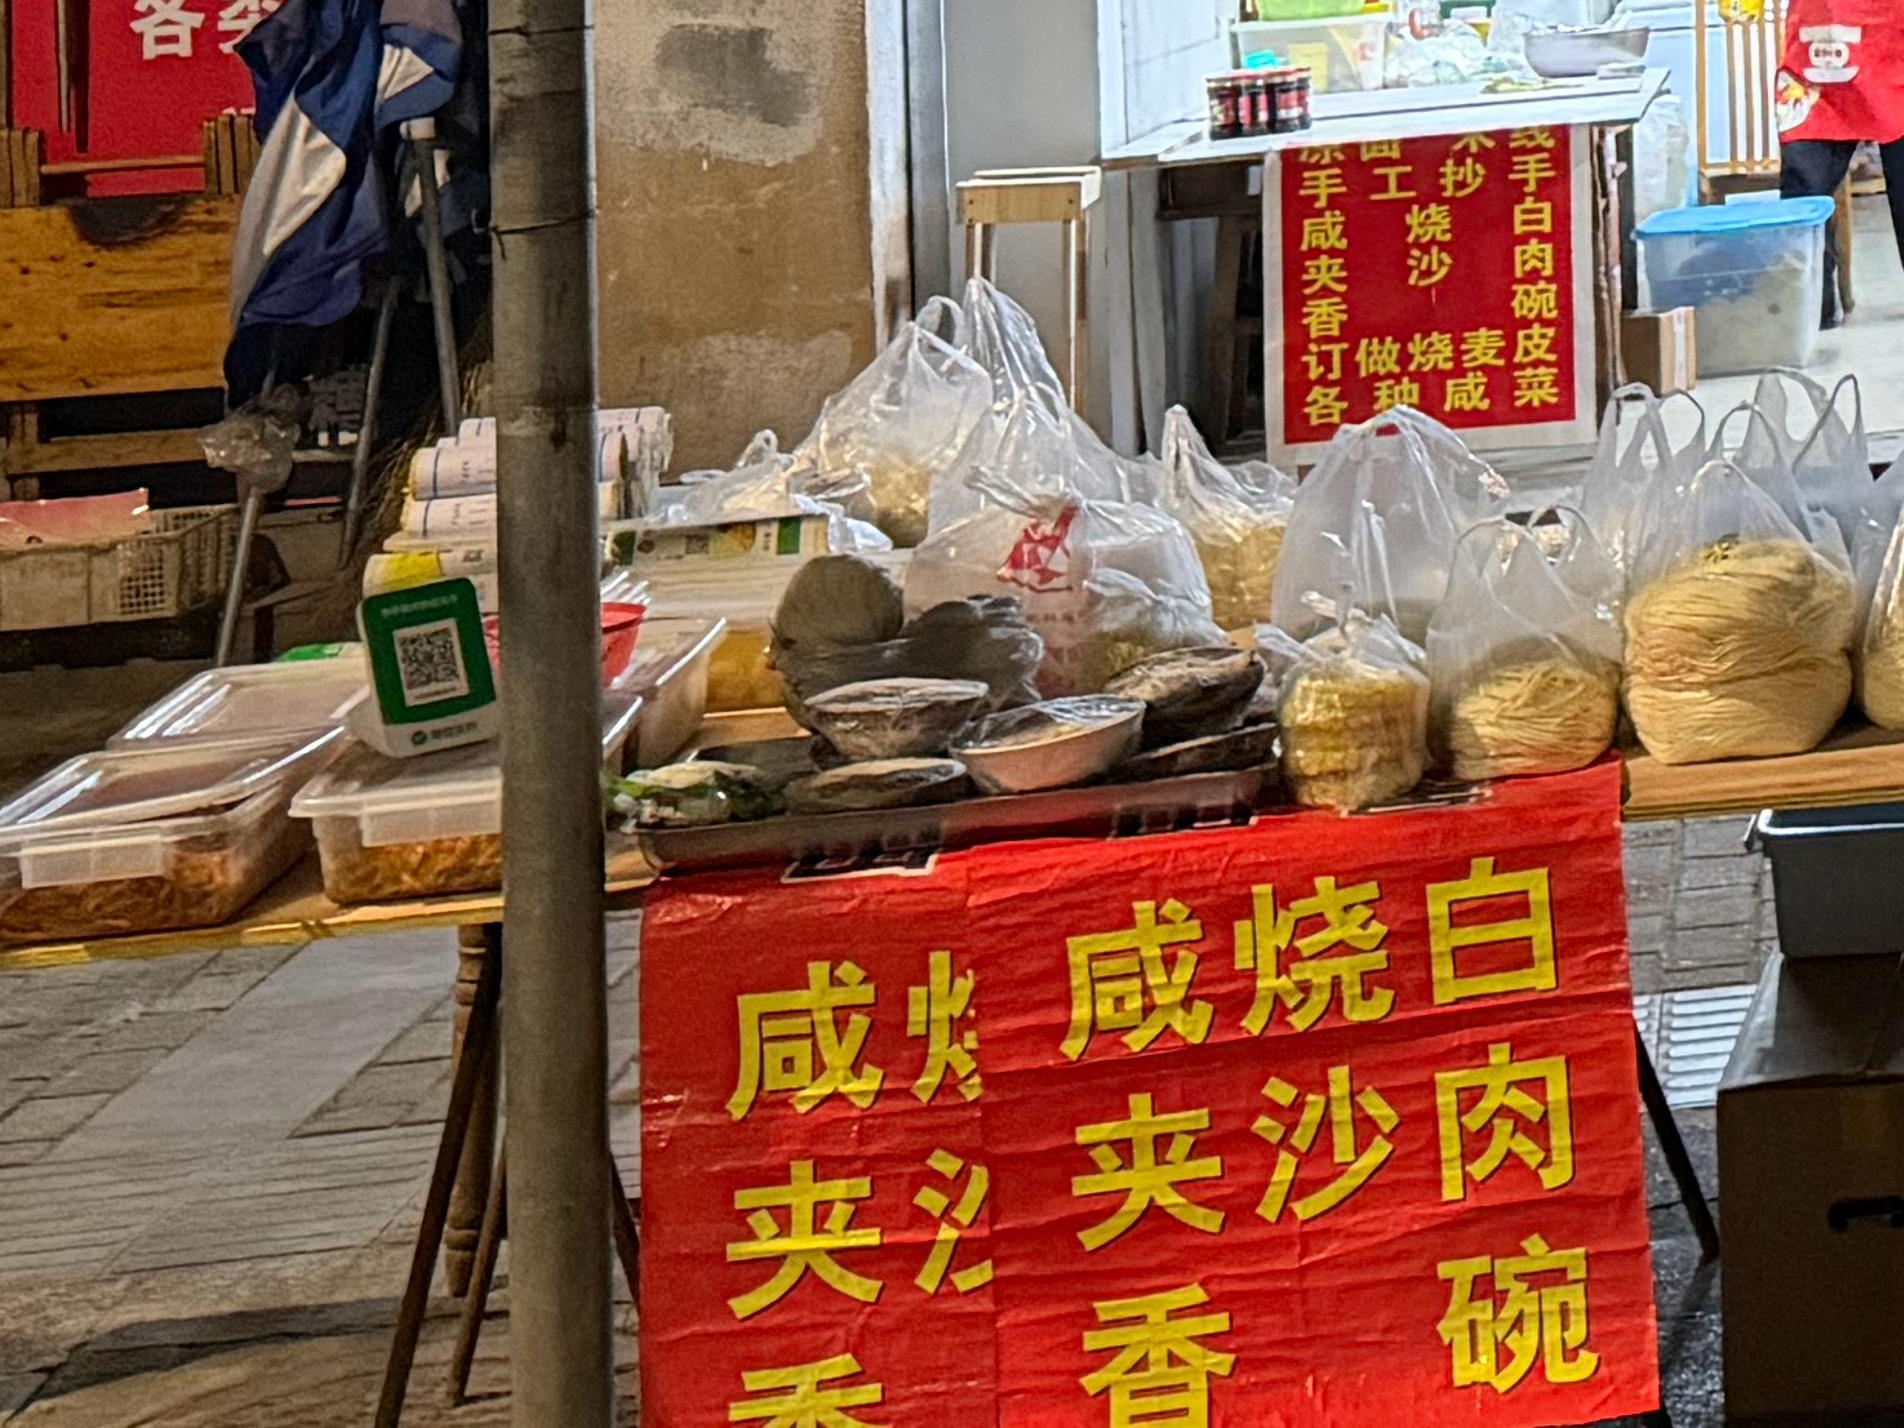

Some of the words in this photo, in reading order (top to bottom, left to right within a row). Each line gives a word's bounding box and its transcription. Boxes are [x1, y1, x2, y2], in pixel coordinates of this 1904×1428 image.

[1060, 855, 1560, 1062] 咸烧白
[1072, 1042, 1575, 1253] 夹沙肉
